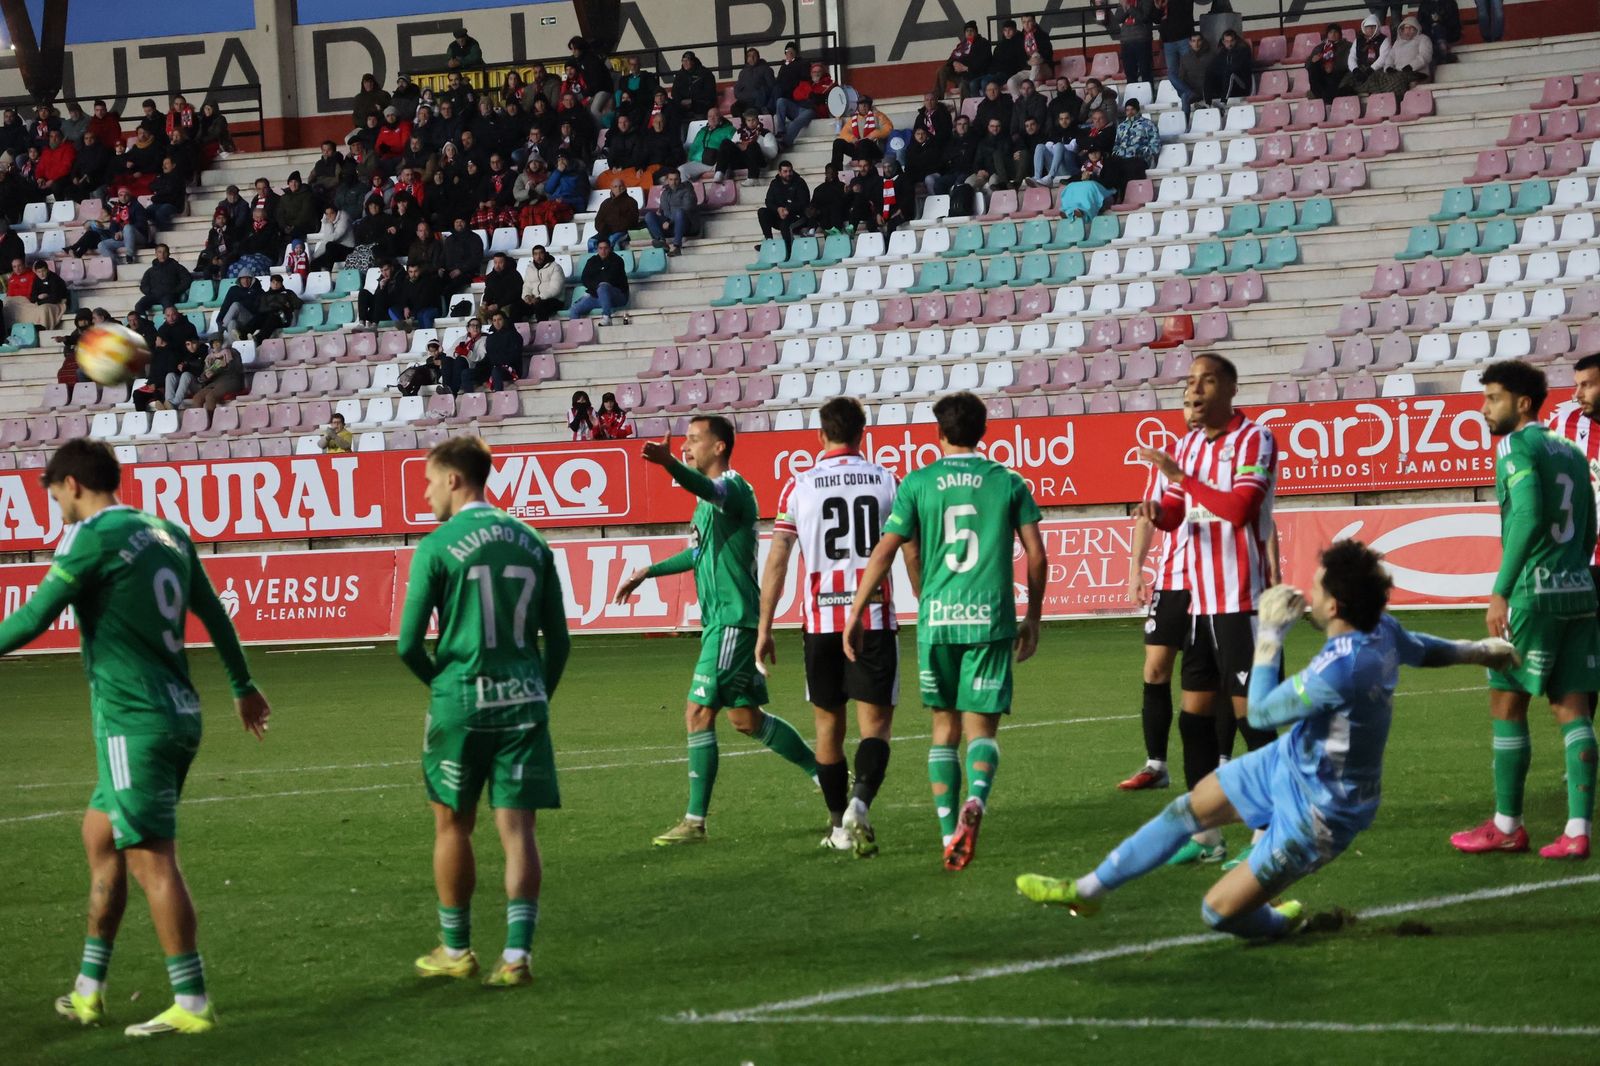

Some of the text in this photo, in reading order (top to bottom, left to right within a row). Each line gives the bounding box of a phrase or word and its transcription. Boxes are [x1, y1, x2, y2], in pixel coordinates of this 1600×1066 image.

[844, 473, 882, 488] CODINA
[937, 472, 983, 491] JAIRO
[1379, 463, 1388, 475] Y
[1396, 457, 1493, 475] JAMONES
[134, 456, 382, 538] RURAL
[1551, 473, 1575, 544] 3
[447, 525, 515, 563] ÁLVARO
[822, 496, 879, 560] 20
[944, 504, 979, 573] 5
[245, 575, 359, 605] VERSUS
[466, 564, 537, 649] 17
[152, 566, 185, 655] 9
[255, 605, 347, 622] E-LEARNING
[930, 600, 991, 623] Prace
